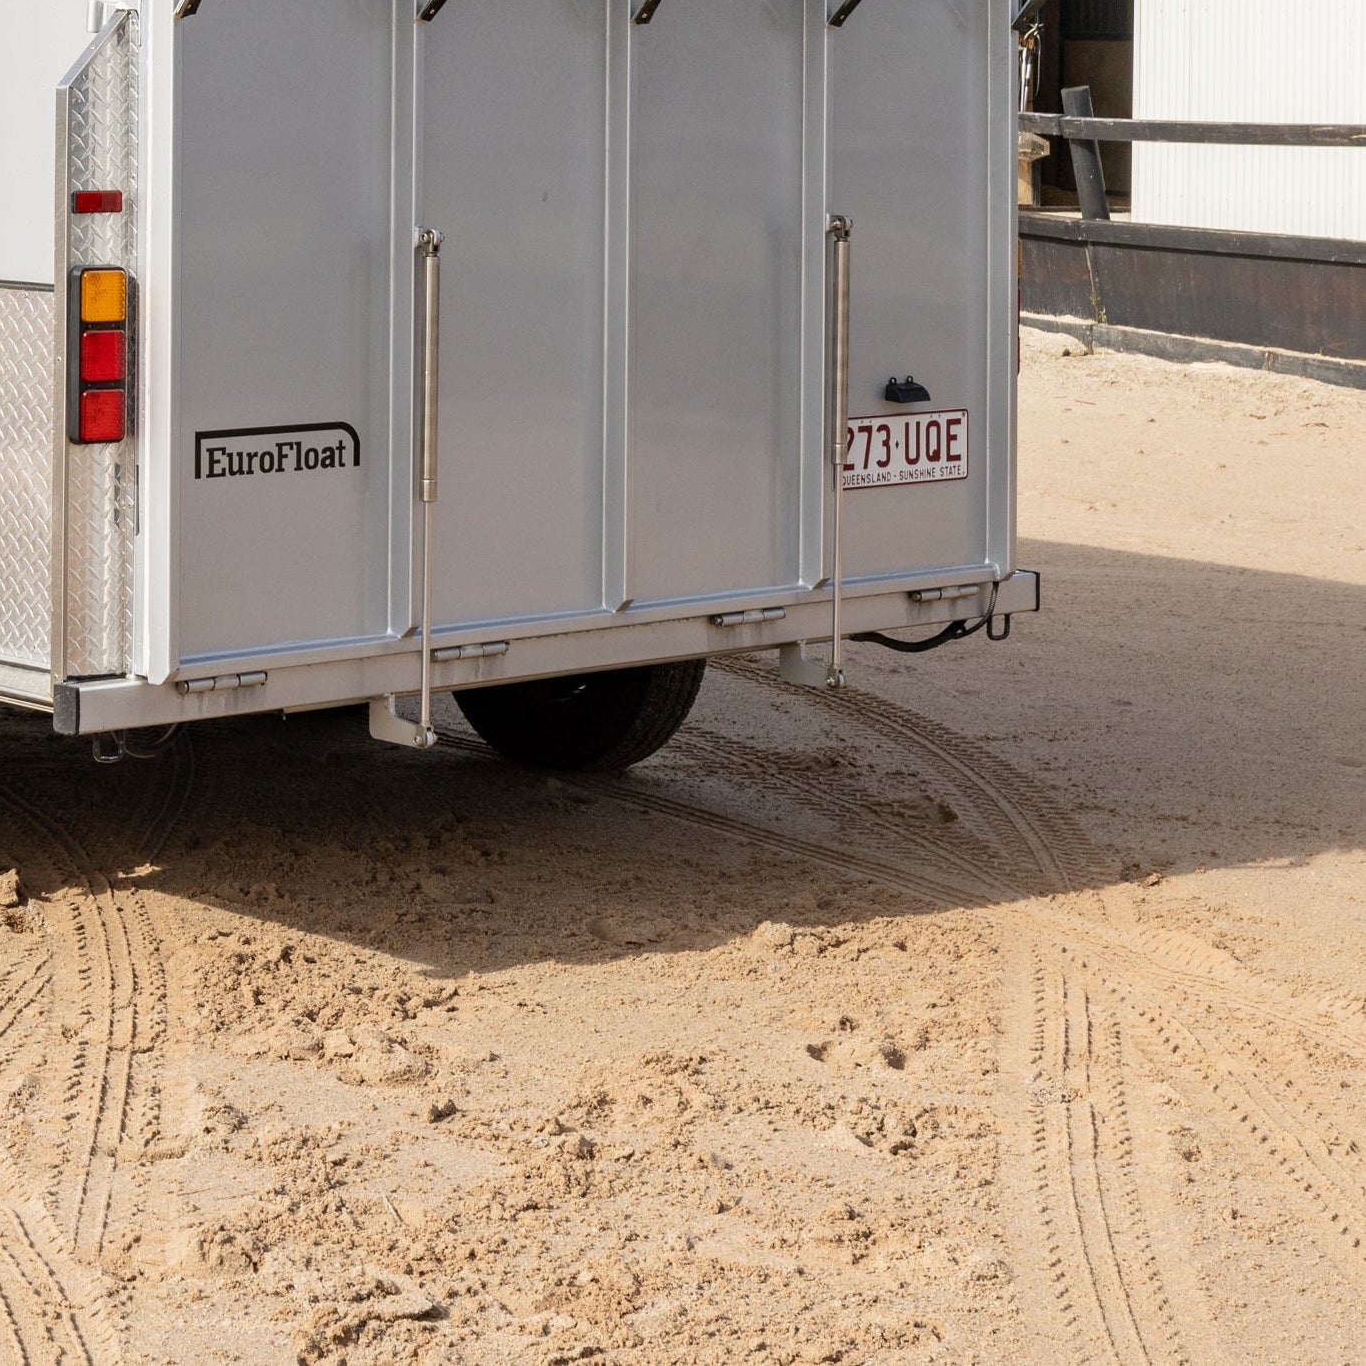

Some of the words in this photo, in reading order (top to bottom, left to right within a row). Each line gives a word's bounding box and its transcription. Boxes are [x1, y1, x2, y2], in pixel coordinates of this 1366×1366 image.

[205, 439, 347, 479] EuroFloat
[899, 467, 936, 481] SUNSHINE
[940, 465, 961, 477] STATE
